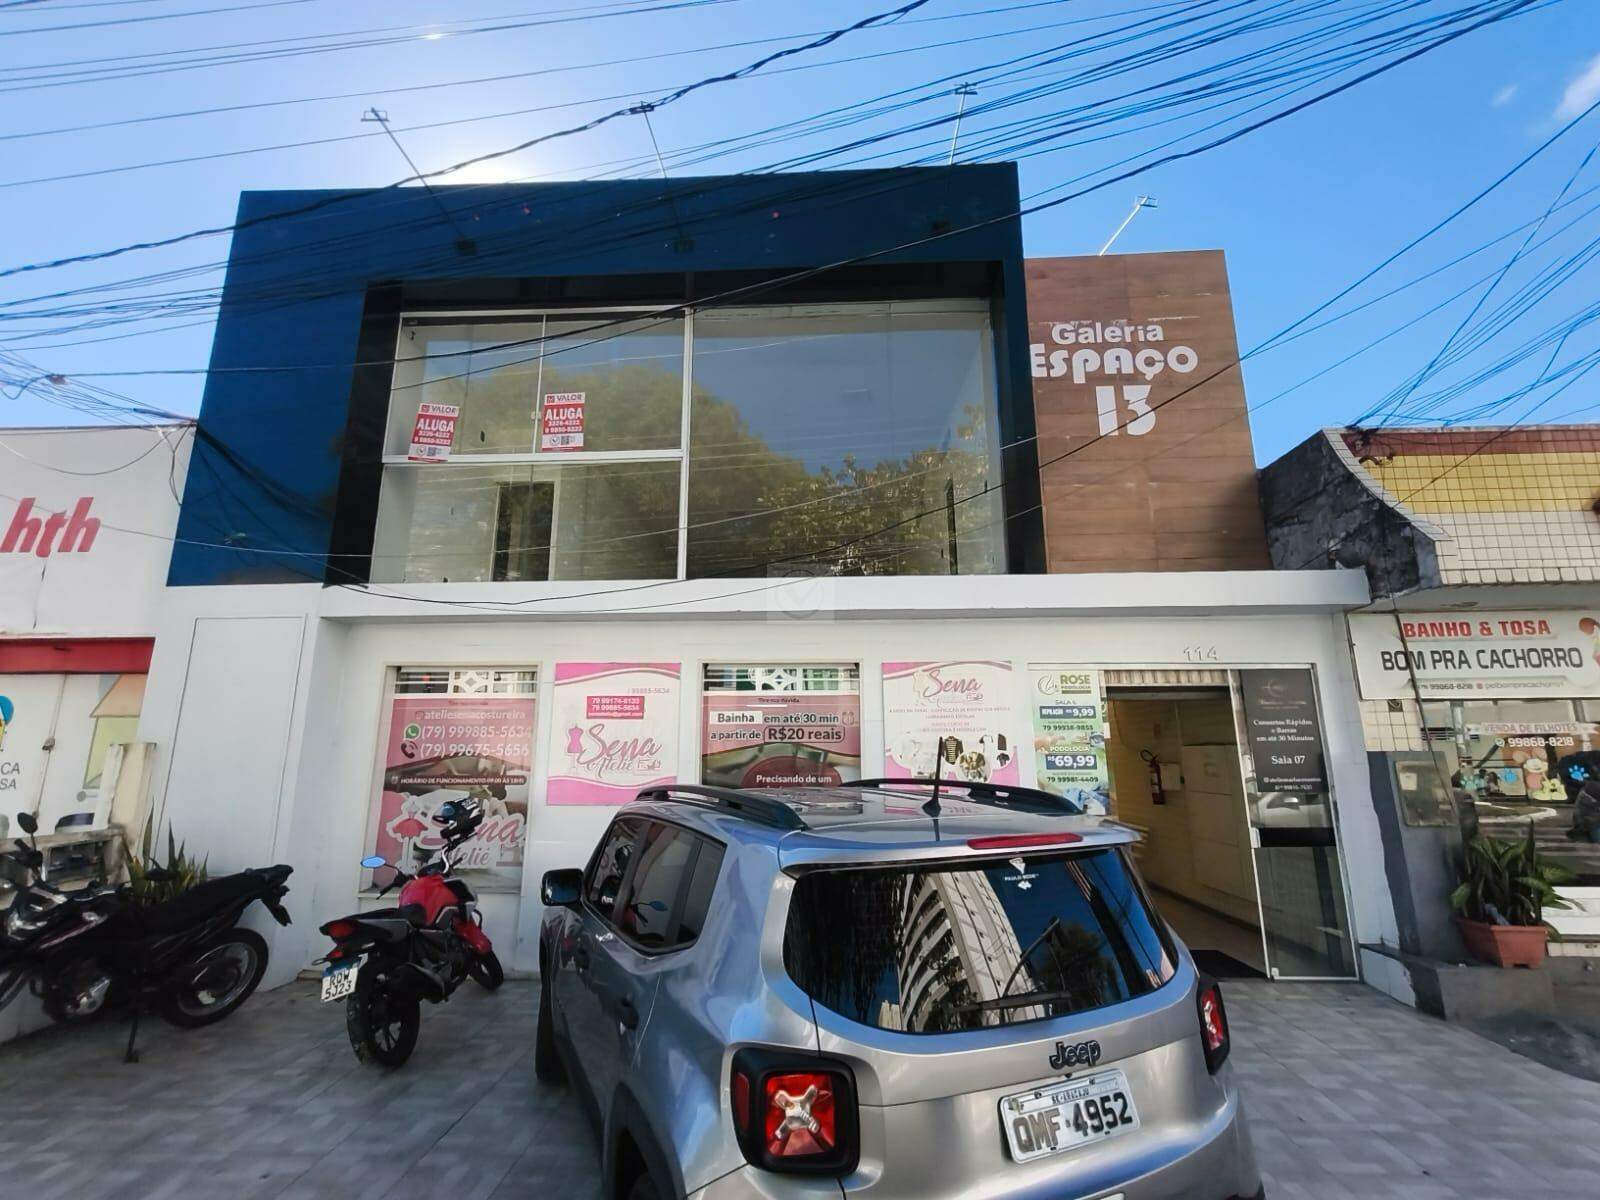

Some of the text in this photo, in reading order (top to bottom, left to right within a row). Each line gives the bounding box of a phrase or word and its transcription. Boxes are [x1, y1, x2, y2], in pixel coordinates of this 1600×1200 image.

[1051, 322, 1165, 345] Galeria
[557, 393, 583, 402] VALOR
[431, 405, 457, 415] VALOR
[544, 408, 584, 421] ALUGA
[1095, 384, 1157, 436] 13
[416, 418, 454, 434] ALUGA
[0, 496, 102, 558] hth
[1402, 619, 1551, 638] BANHO & TOSA
[1183, 646, 1217, 661] 114
[1380, 647, 1584, 671] BOM PRA CACHORRO
[923, 669, 983, 698] Sena
[1060, 674, 1091, 685] ROSE
[717, 712, 839, 723] Bainha em até 30 min
[421, 725, 446, 739] (79)
[719, 729, 747, 741] partir
[749, 730, 761, 739] de
[768, 728, 805, 742] R$20
[807, 728, 842, 740] reais
[419, 743, 446, 758] (79)
[576, 723, 662, 766] Sena
[1271, 755, 1306, 765] Sala 07
[756, 774, 832, 784] Precisando de um
[1048, 1039, 1101, 1070] Jeep
